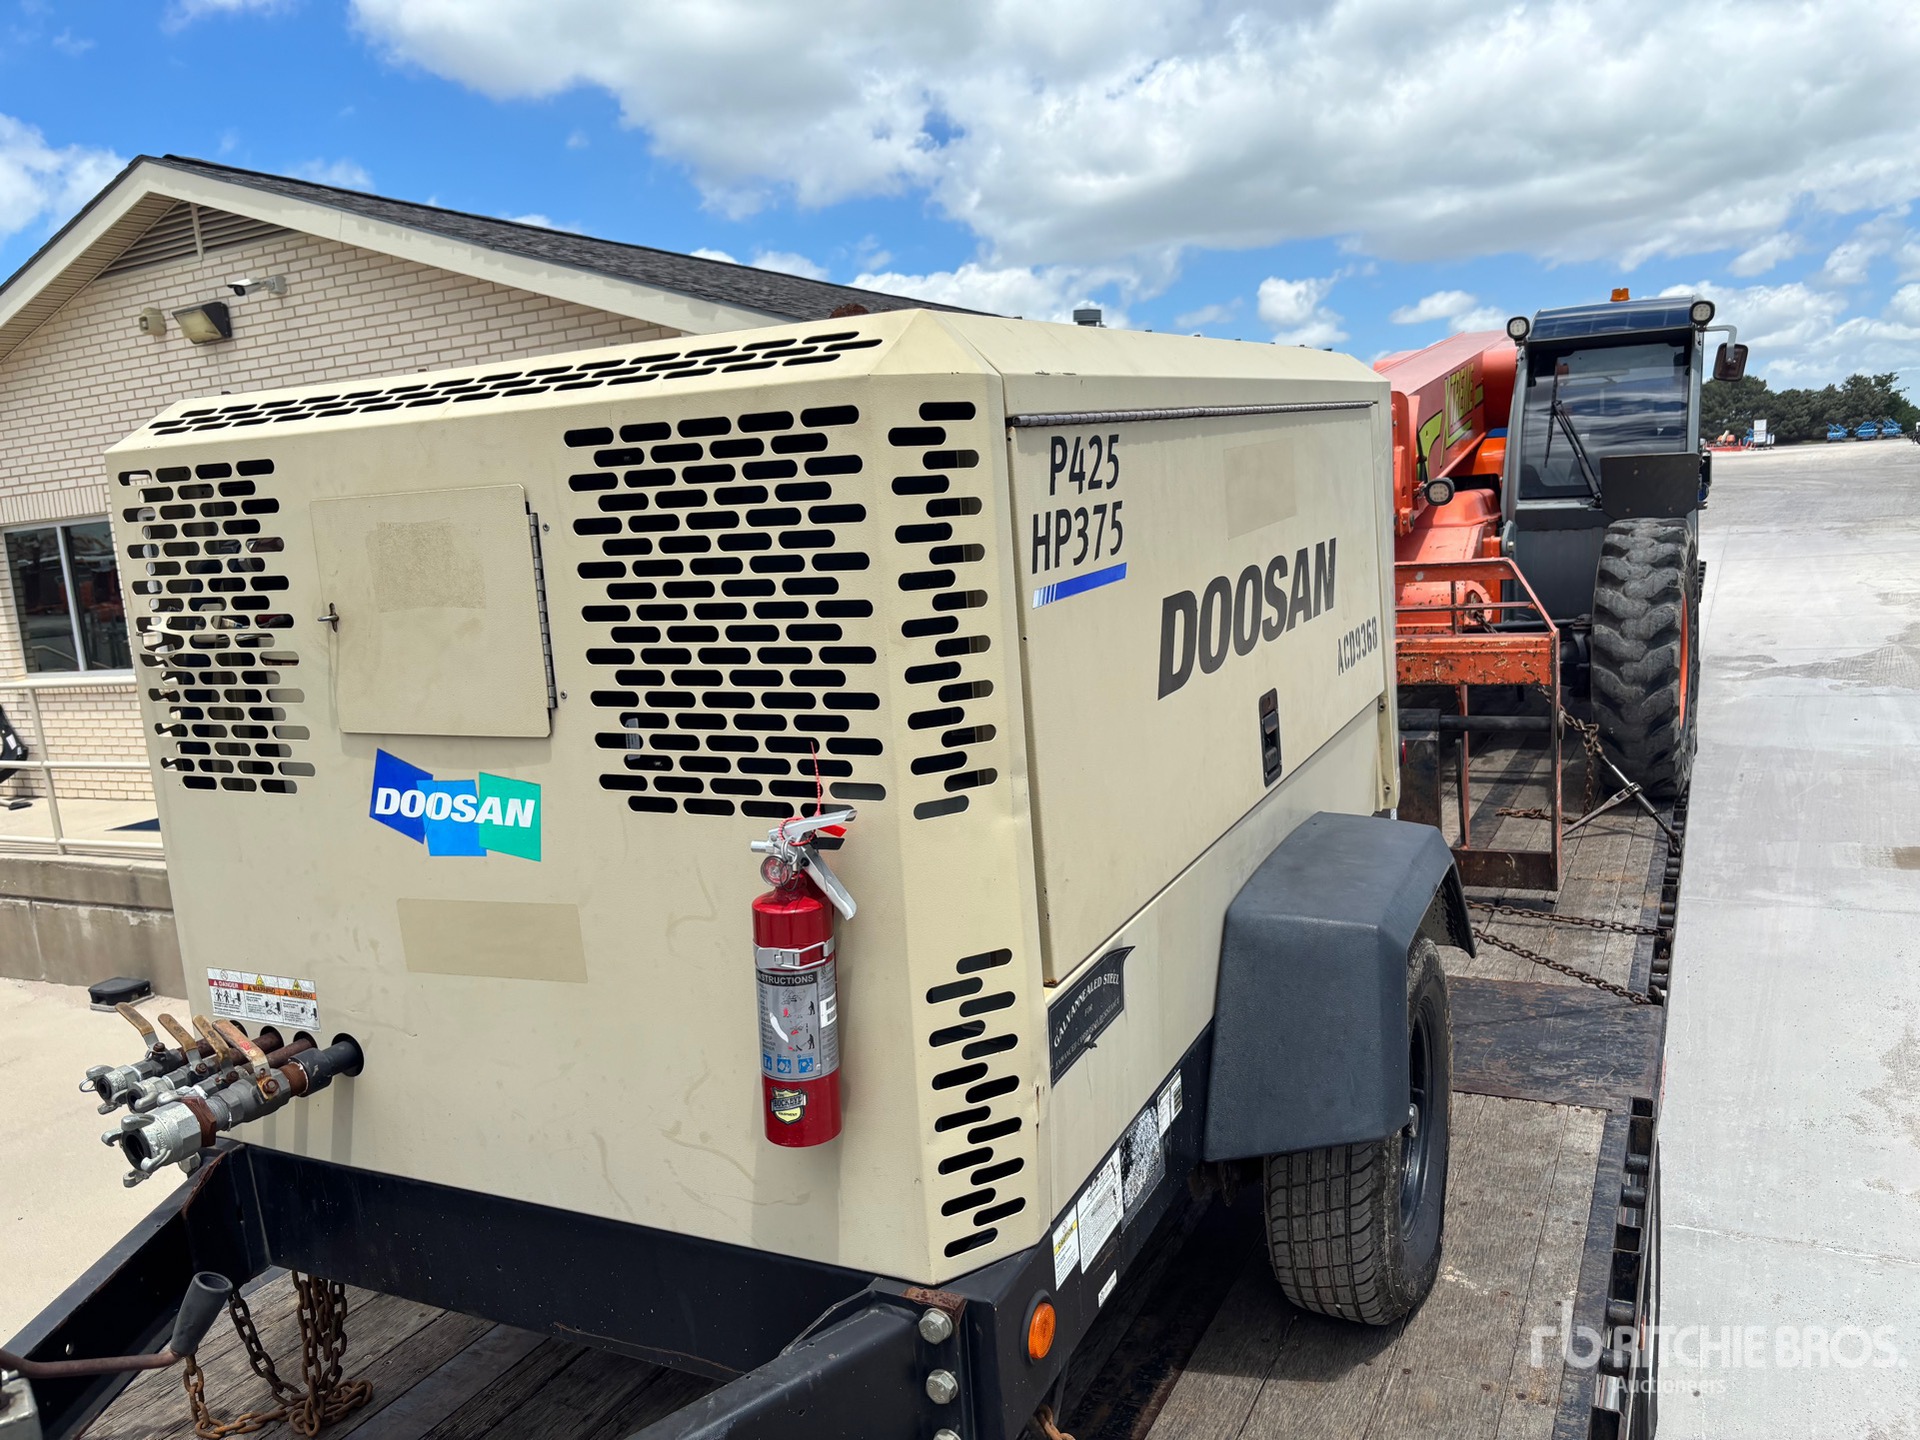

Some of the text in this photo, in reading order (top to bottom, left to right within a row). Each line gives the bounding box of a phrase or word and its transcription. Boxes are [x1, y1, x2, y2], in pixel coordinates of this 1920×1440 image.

[1049, 433, 1120, 496] P425
[1031, 500, 1124, 575] HP375
[1157, 537, 1337, 701] DOOSAN
[1336, 616, 1378, 677] ACD9368
[375, 787, 535, 828] DOOSAN
[1102, 973, 1120, 985] STEEL
